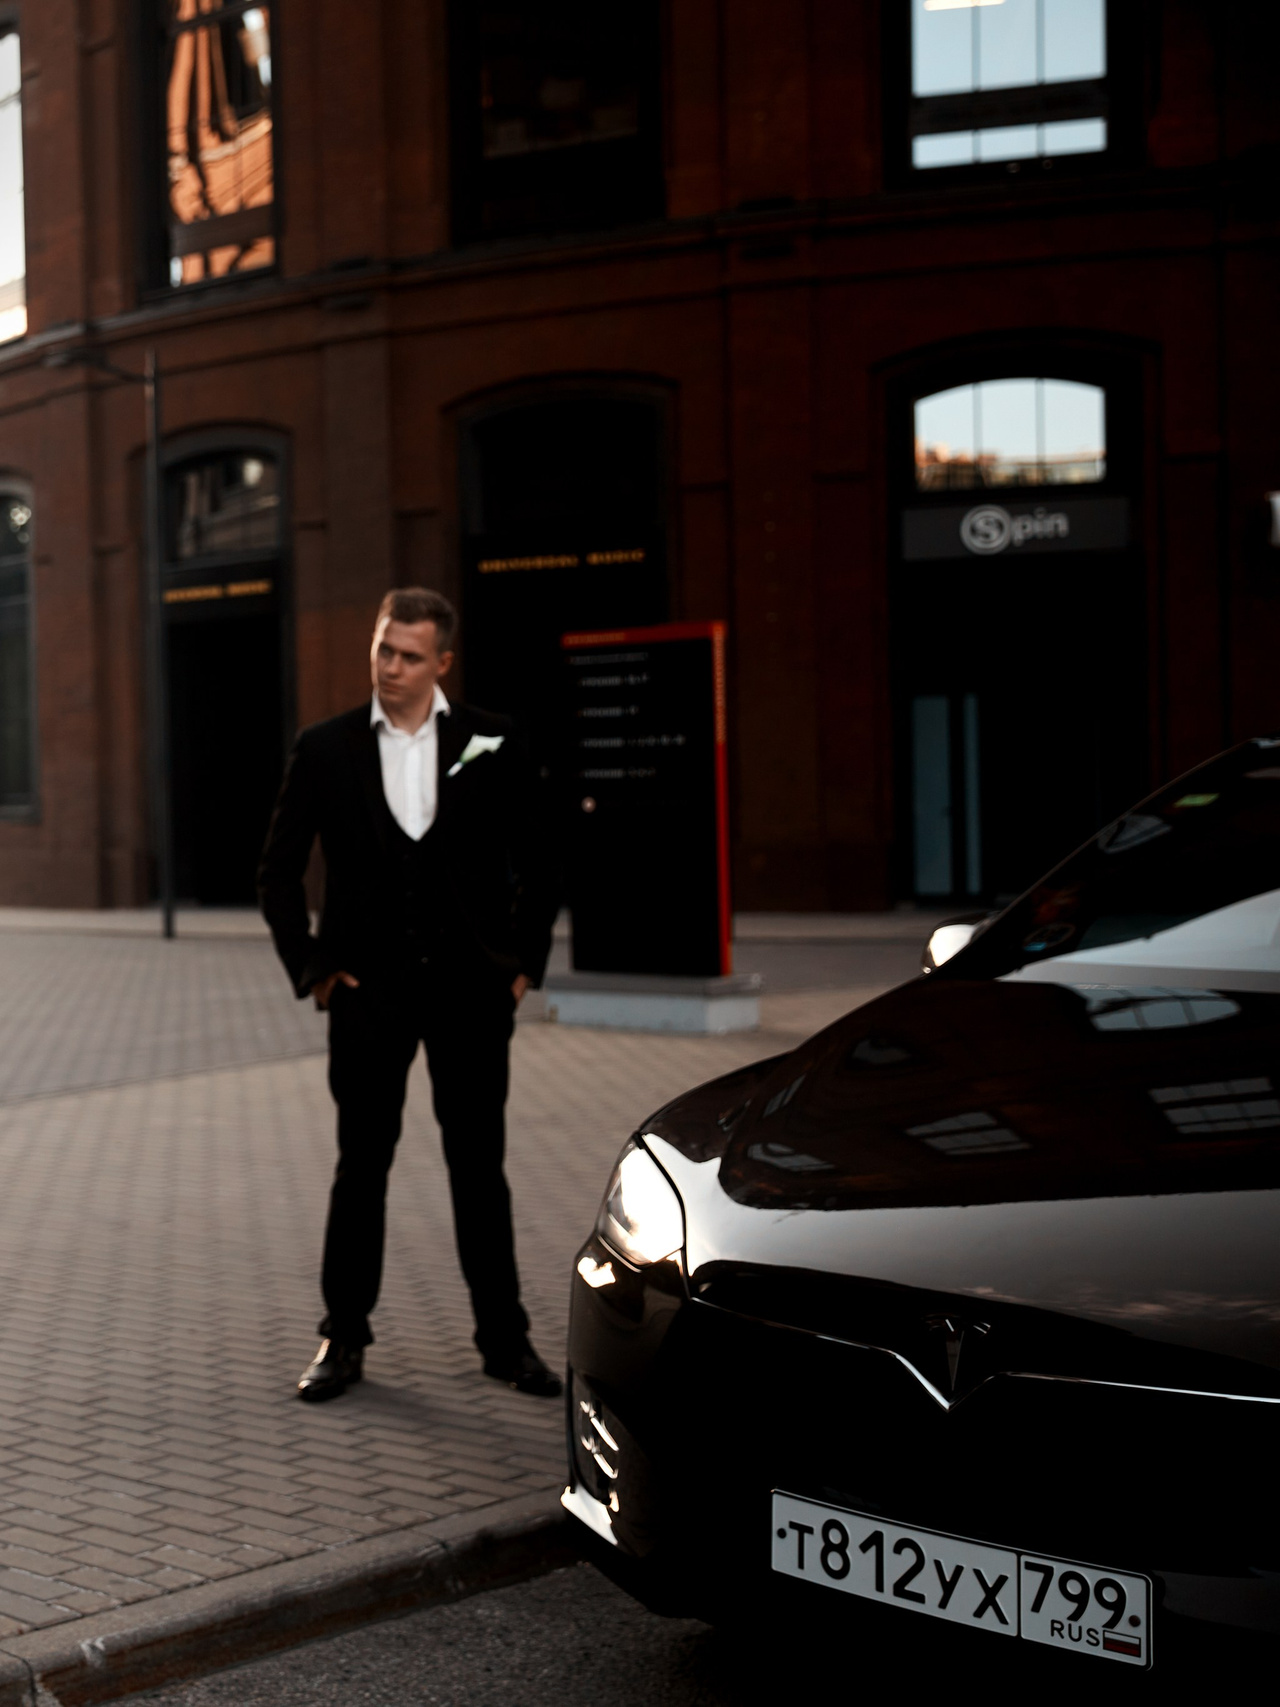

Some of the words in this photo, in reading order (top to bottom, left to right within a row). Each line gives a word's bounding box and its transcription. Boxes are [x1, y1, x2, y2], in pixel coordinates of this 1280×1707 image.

[960, 503, 1069, 555] Spin
[1024, 1560, 1127, 1629] 799
[1050, 1619, 1101, 1648] RUS
